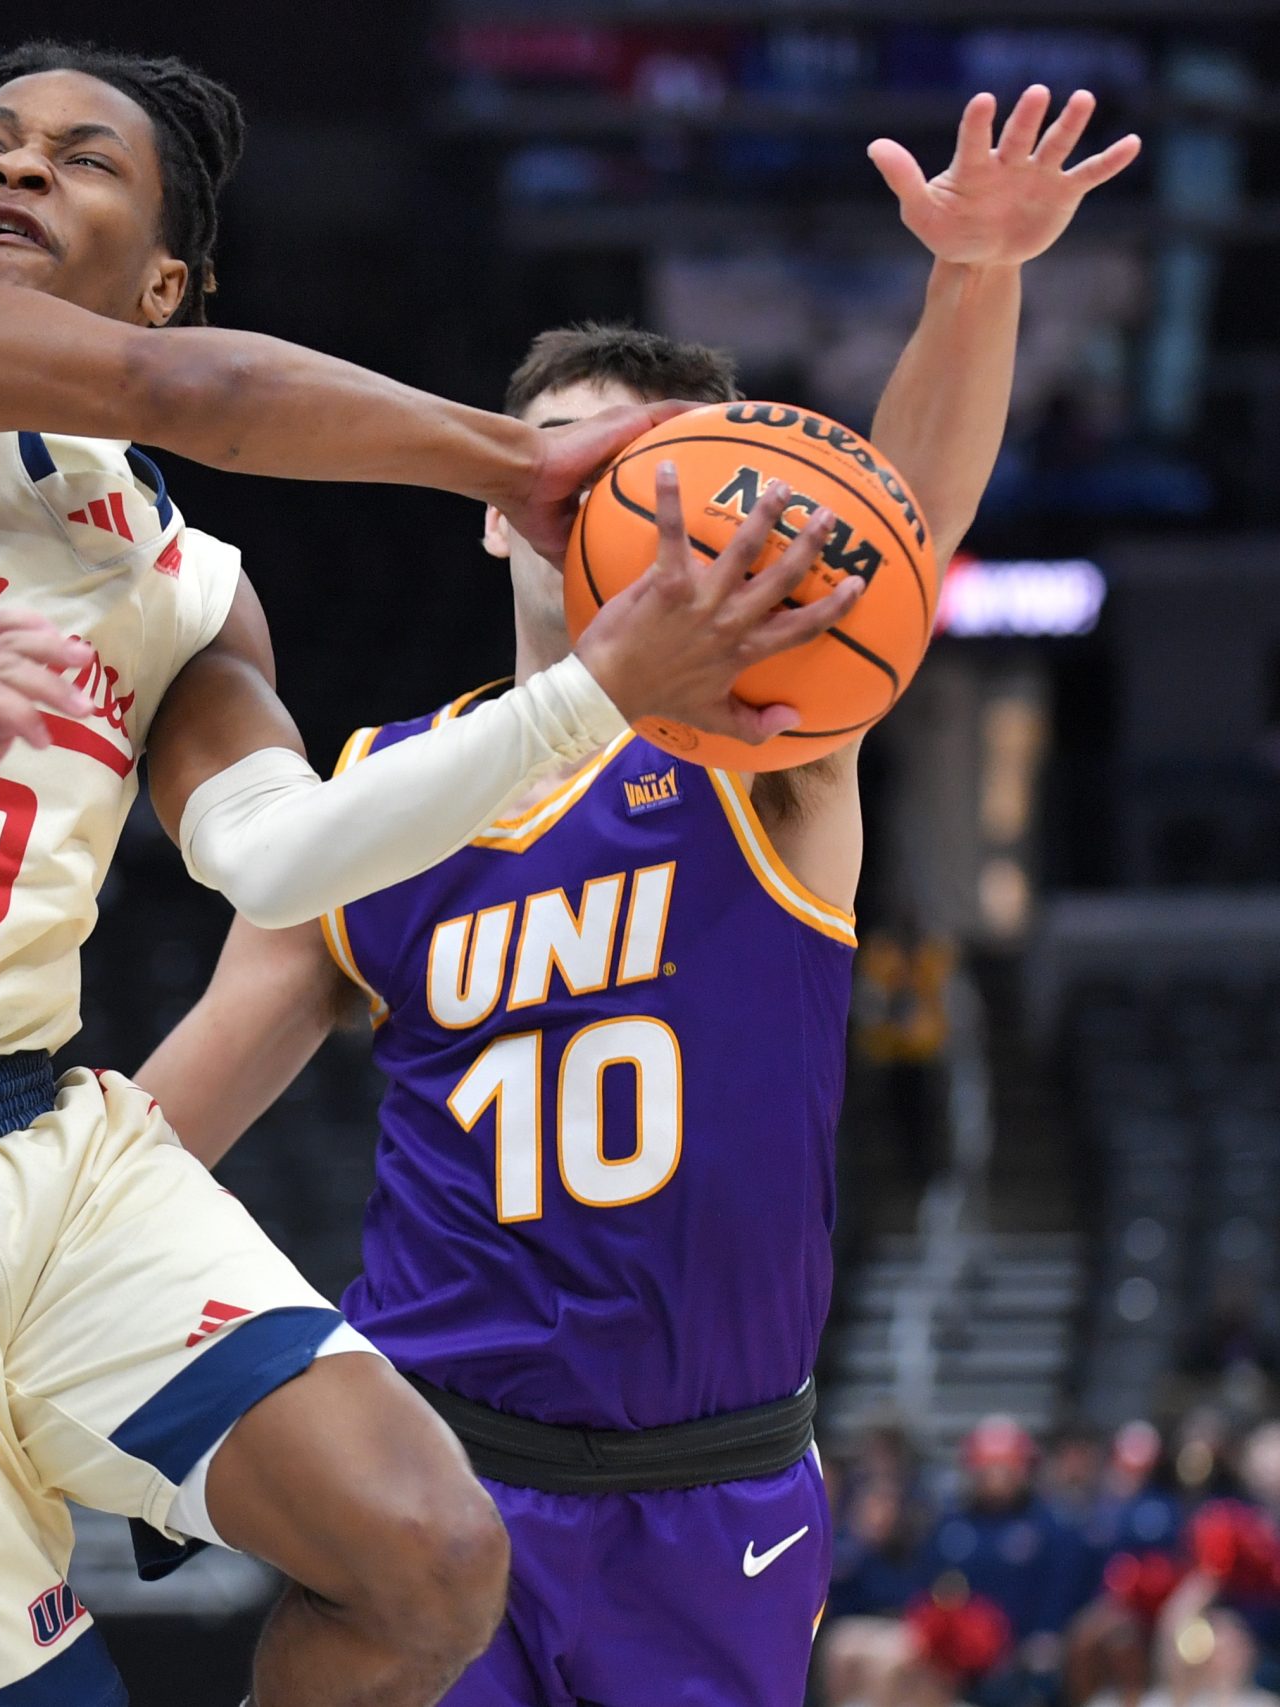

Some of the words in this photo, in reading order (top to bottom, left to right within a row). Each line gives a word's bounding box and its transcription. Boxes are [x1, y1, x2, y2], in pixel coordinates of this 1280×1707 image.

[709, 463, 883, 598] NCAA
[624, 766, 677, 808] VALLEY
[640, 773, 657, 783] THE
[426, 860, 677, 1031] UNI
[445, 1014, 684, 1225] 10
